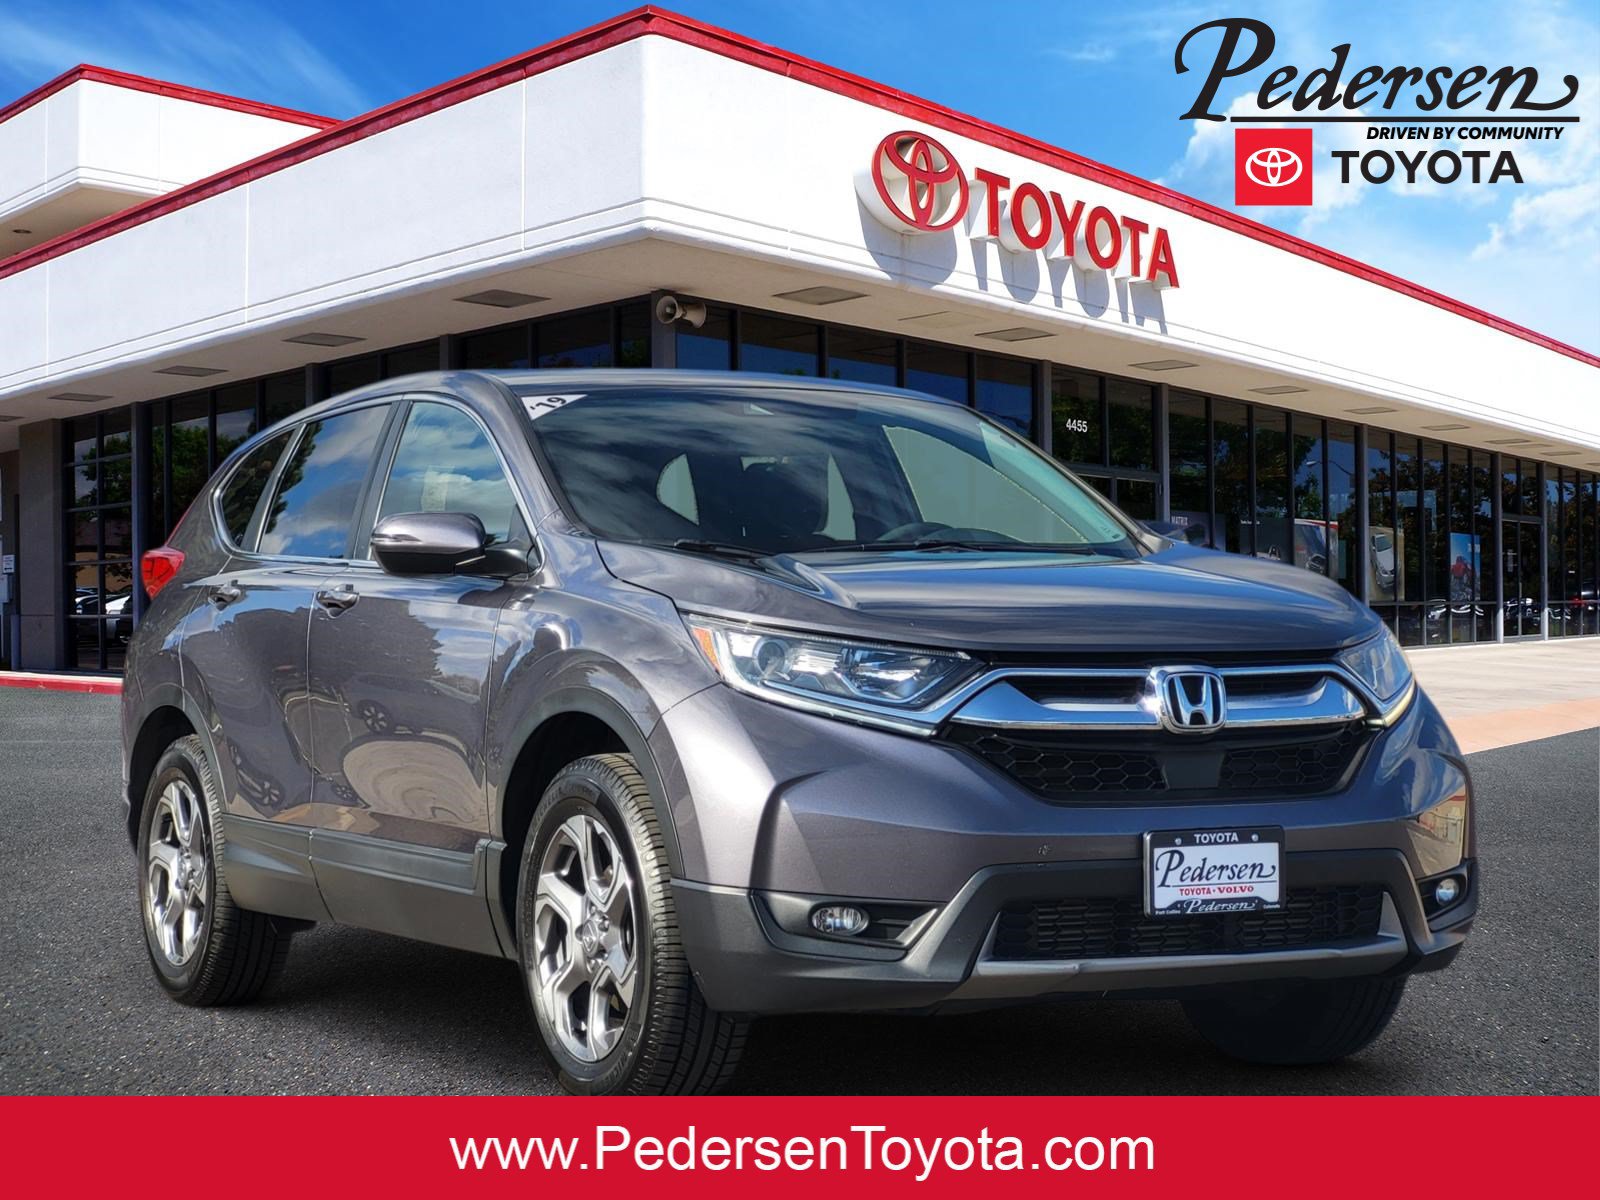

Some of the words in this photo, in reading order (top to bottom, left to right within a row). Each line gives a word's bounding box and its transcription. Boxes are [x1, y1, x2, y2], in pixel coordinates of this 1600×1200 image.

[974, 166, 1180, 289] TOYOTA
[1065, 418, 1088, 433] 4455
[1194, 832, 1239, 844] TOYOTA
[1155, 849, 1277, 888] Pedersen
[1179, 887, 1212, 897] TOYOTA
[1217, 885, 1255, 895] VOLVO
